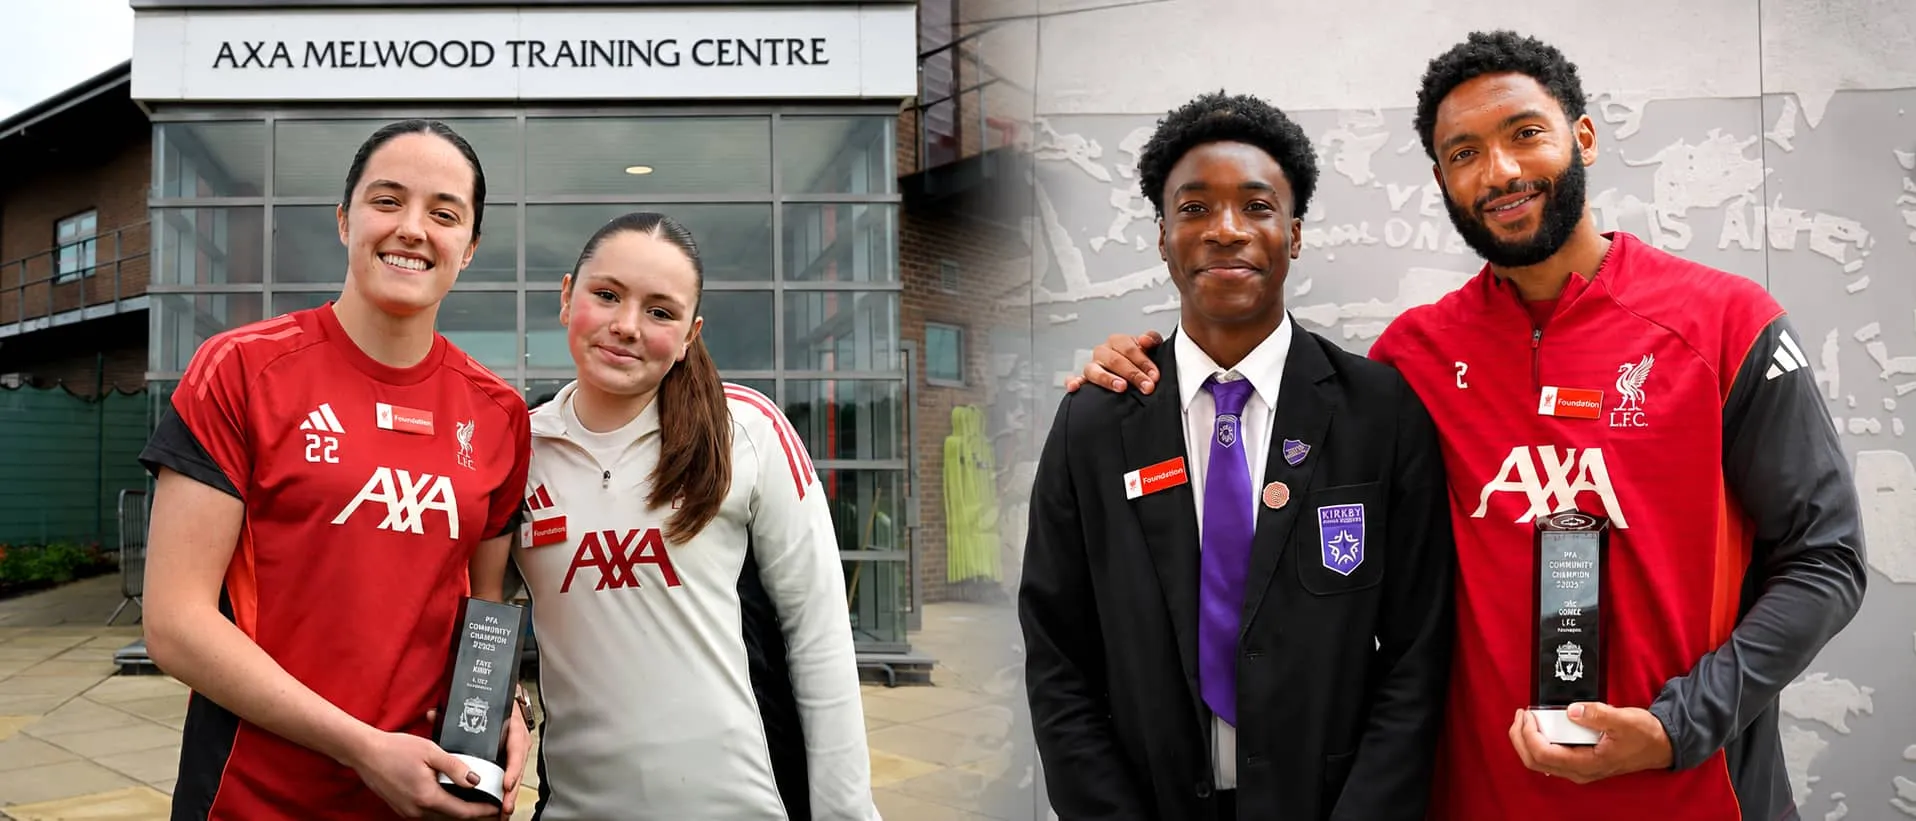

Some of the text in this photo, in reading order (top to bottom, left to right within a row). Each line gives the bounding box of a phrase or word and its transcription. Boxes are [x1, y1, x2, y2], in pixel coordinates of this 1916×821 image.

[212, 38, 830, 69] AXA MELWOOD TRAINING CENTRE
[1557, 399, 1600, 409] Foundation
[1609, 412, 1649, 427] L.F.C.
[305, 433, 340, 463] 22
[1142, 467, 1184, 485] Foundation
[1469, 444, 1630, 529] AXA
[330, 466, 459, 540] AXA
[1322, 507, 1361, 520] KIRKBY
[533, 525, 566, 537] Foundation
[559, 528, 682, 594] AXA
[1549, 560, 1593, 569] COMMUNITY
[468, 622, 512, 637] COMMUNITY
